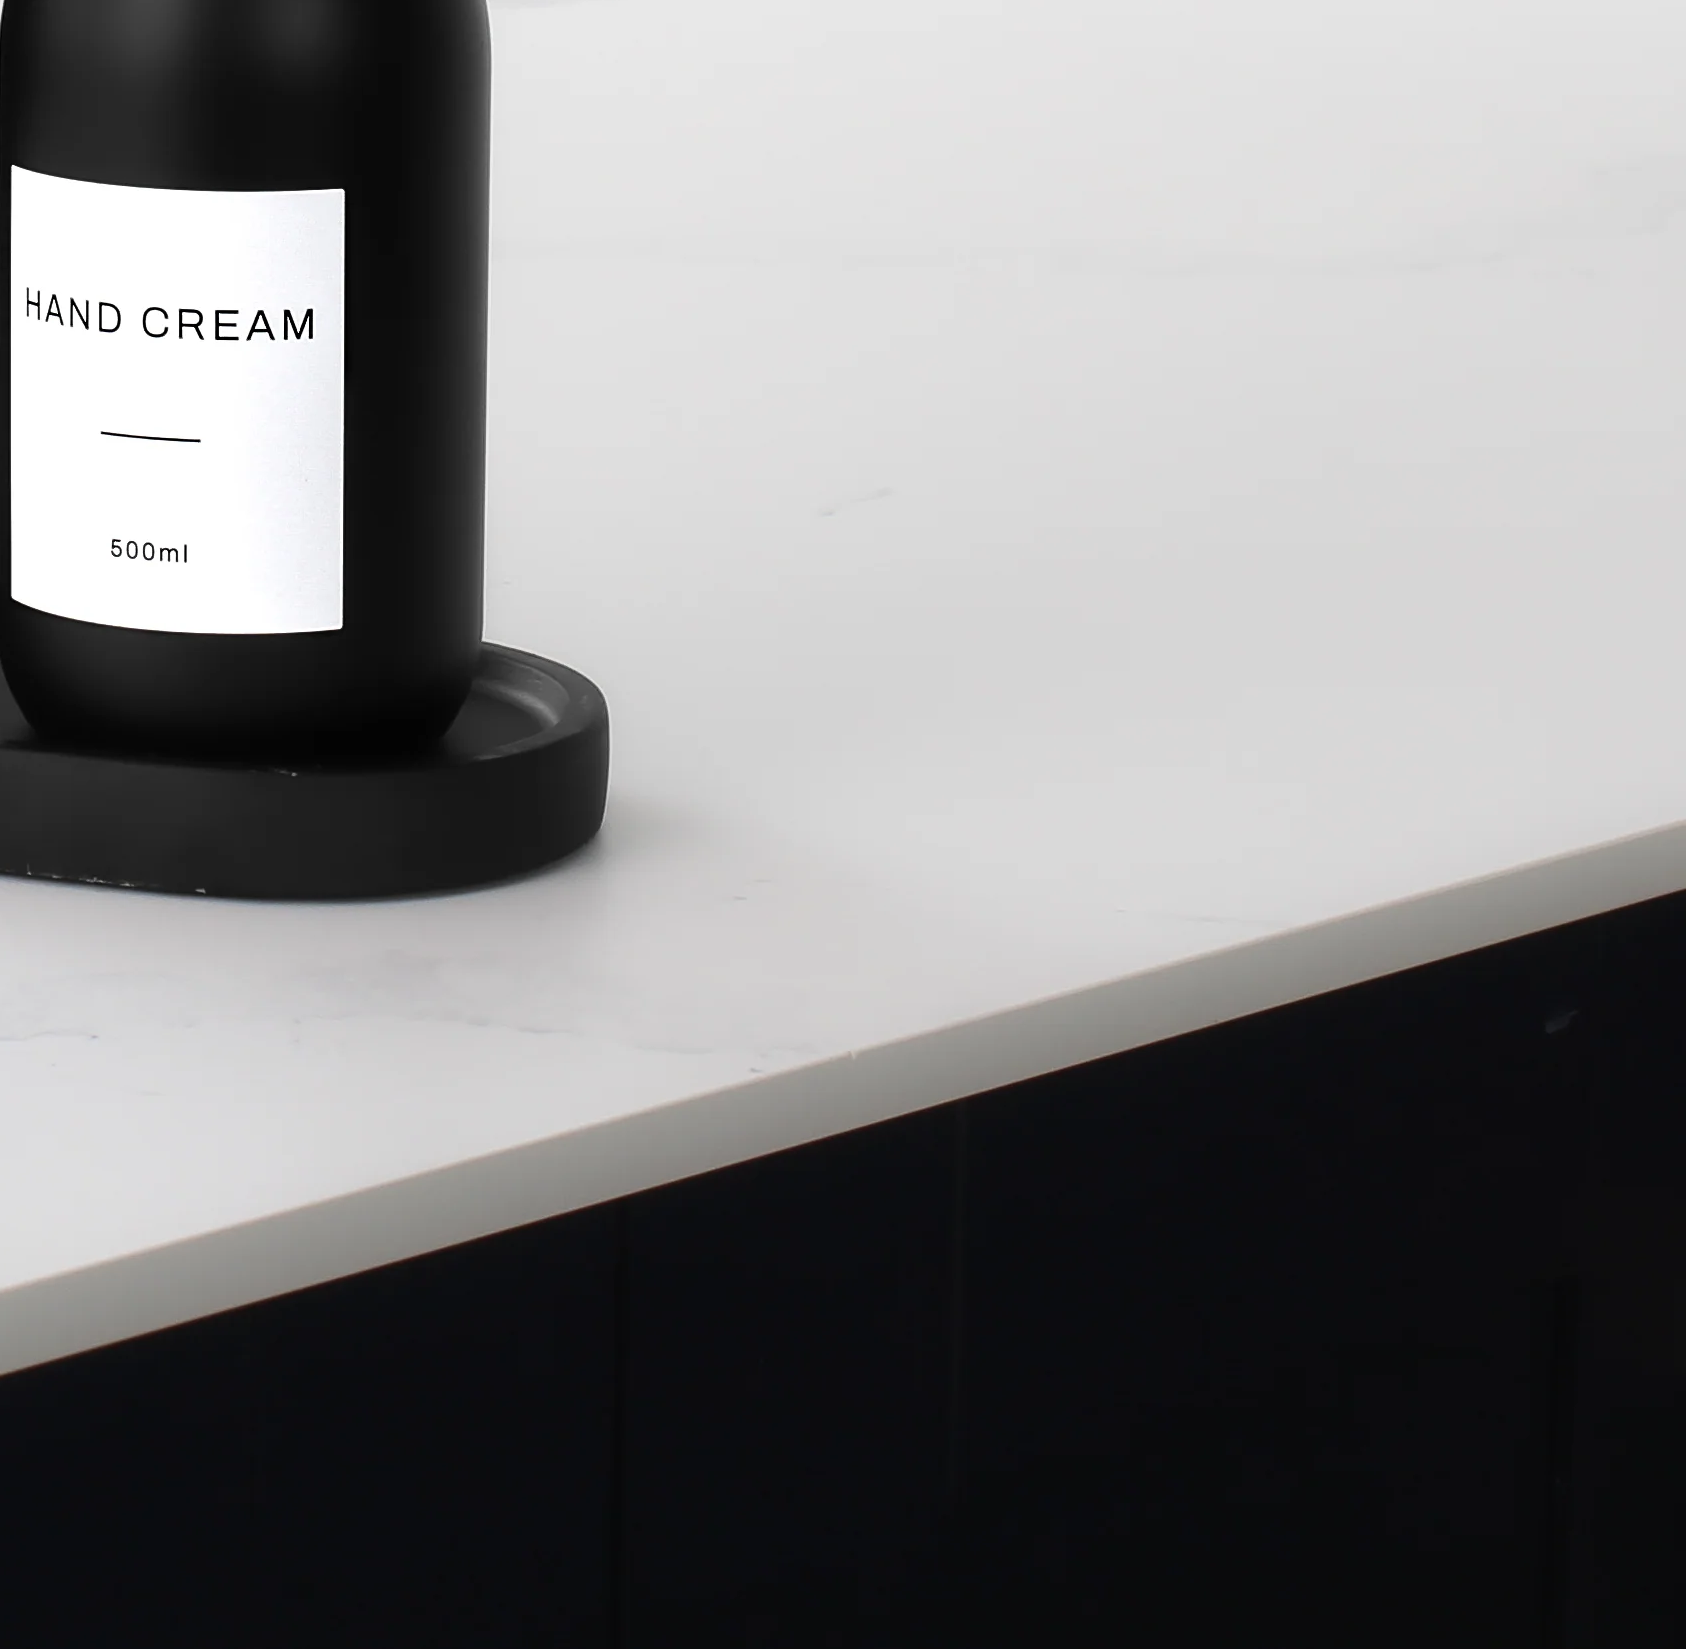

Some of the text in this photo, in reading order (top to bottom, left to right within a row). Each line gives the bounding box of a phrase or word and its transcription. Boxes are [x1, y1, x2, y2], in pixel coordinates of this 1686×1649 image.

[25, 285, 315, 342] HAND CREAM
[109, 537, 189, 564] 500ml
